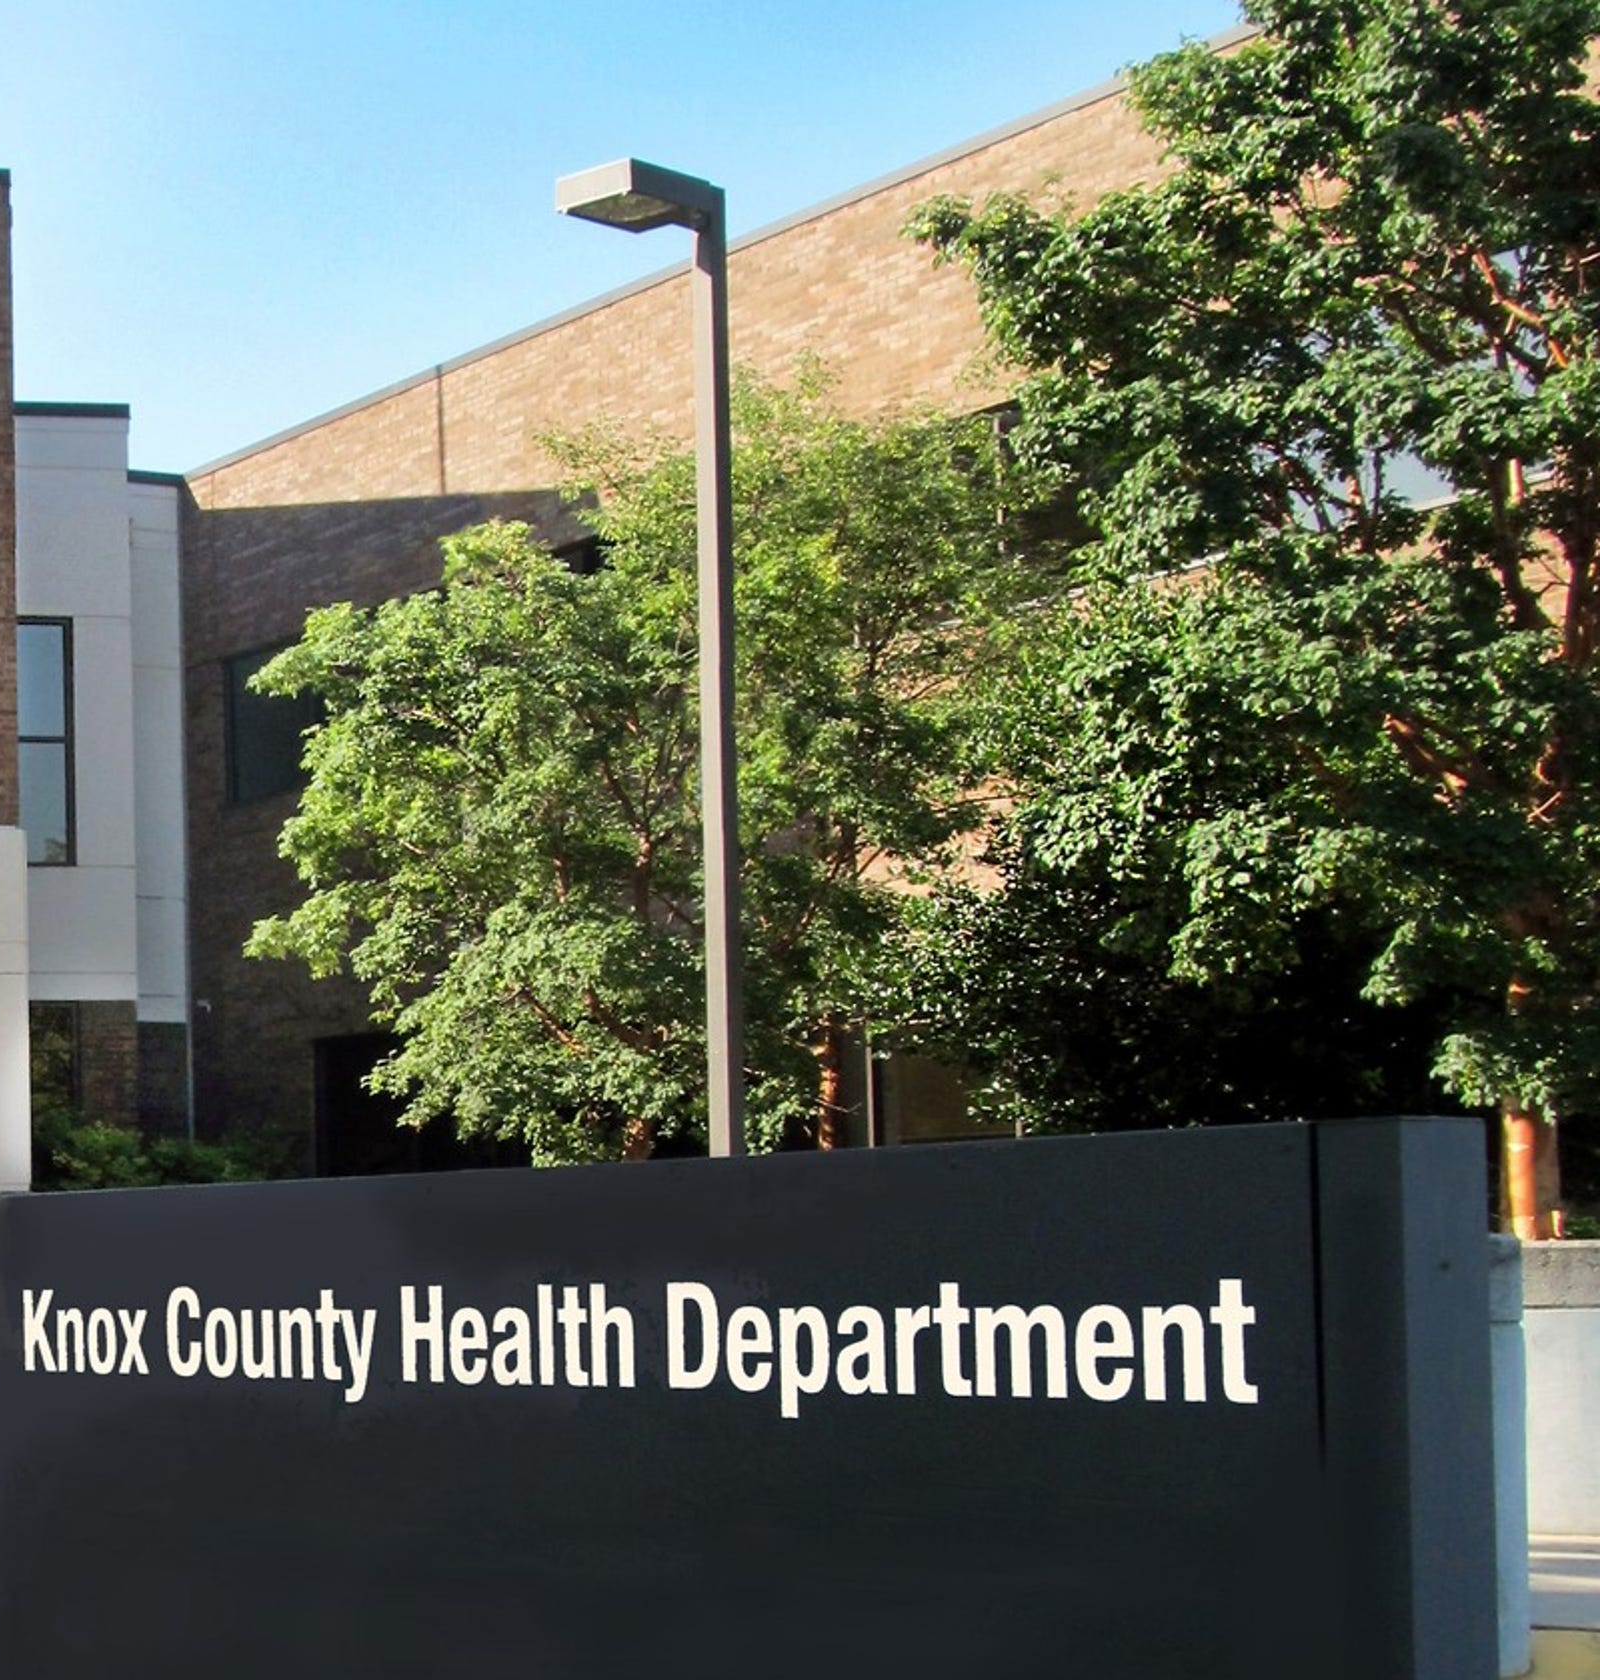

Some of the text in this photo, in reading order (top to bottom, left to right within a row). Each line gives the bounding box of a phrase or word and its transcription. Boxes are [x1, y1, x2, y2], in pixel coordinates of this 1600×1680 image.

[22, 1278, 1259, 1419] Knox County Health Department
